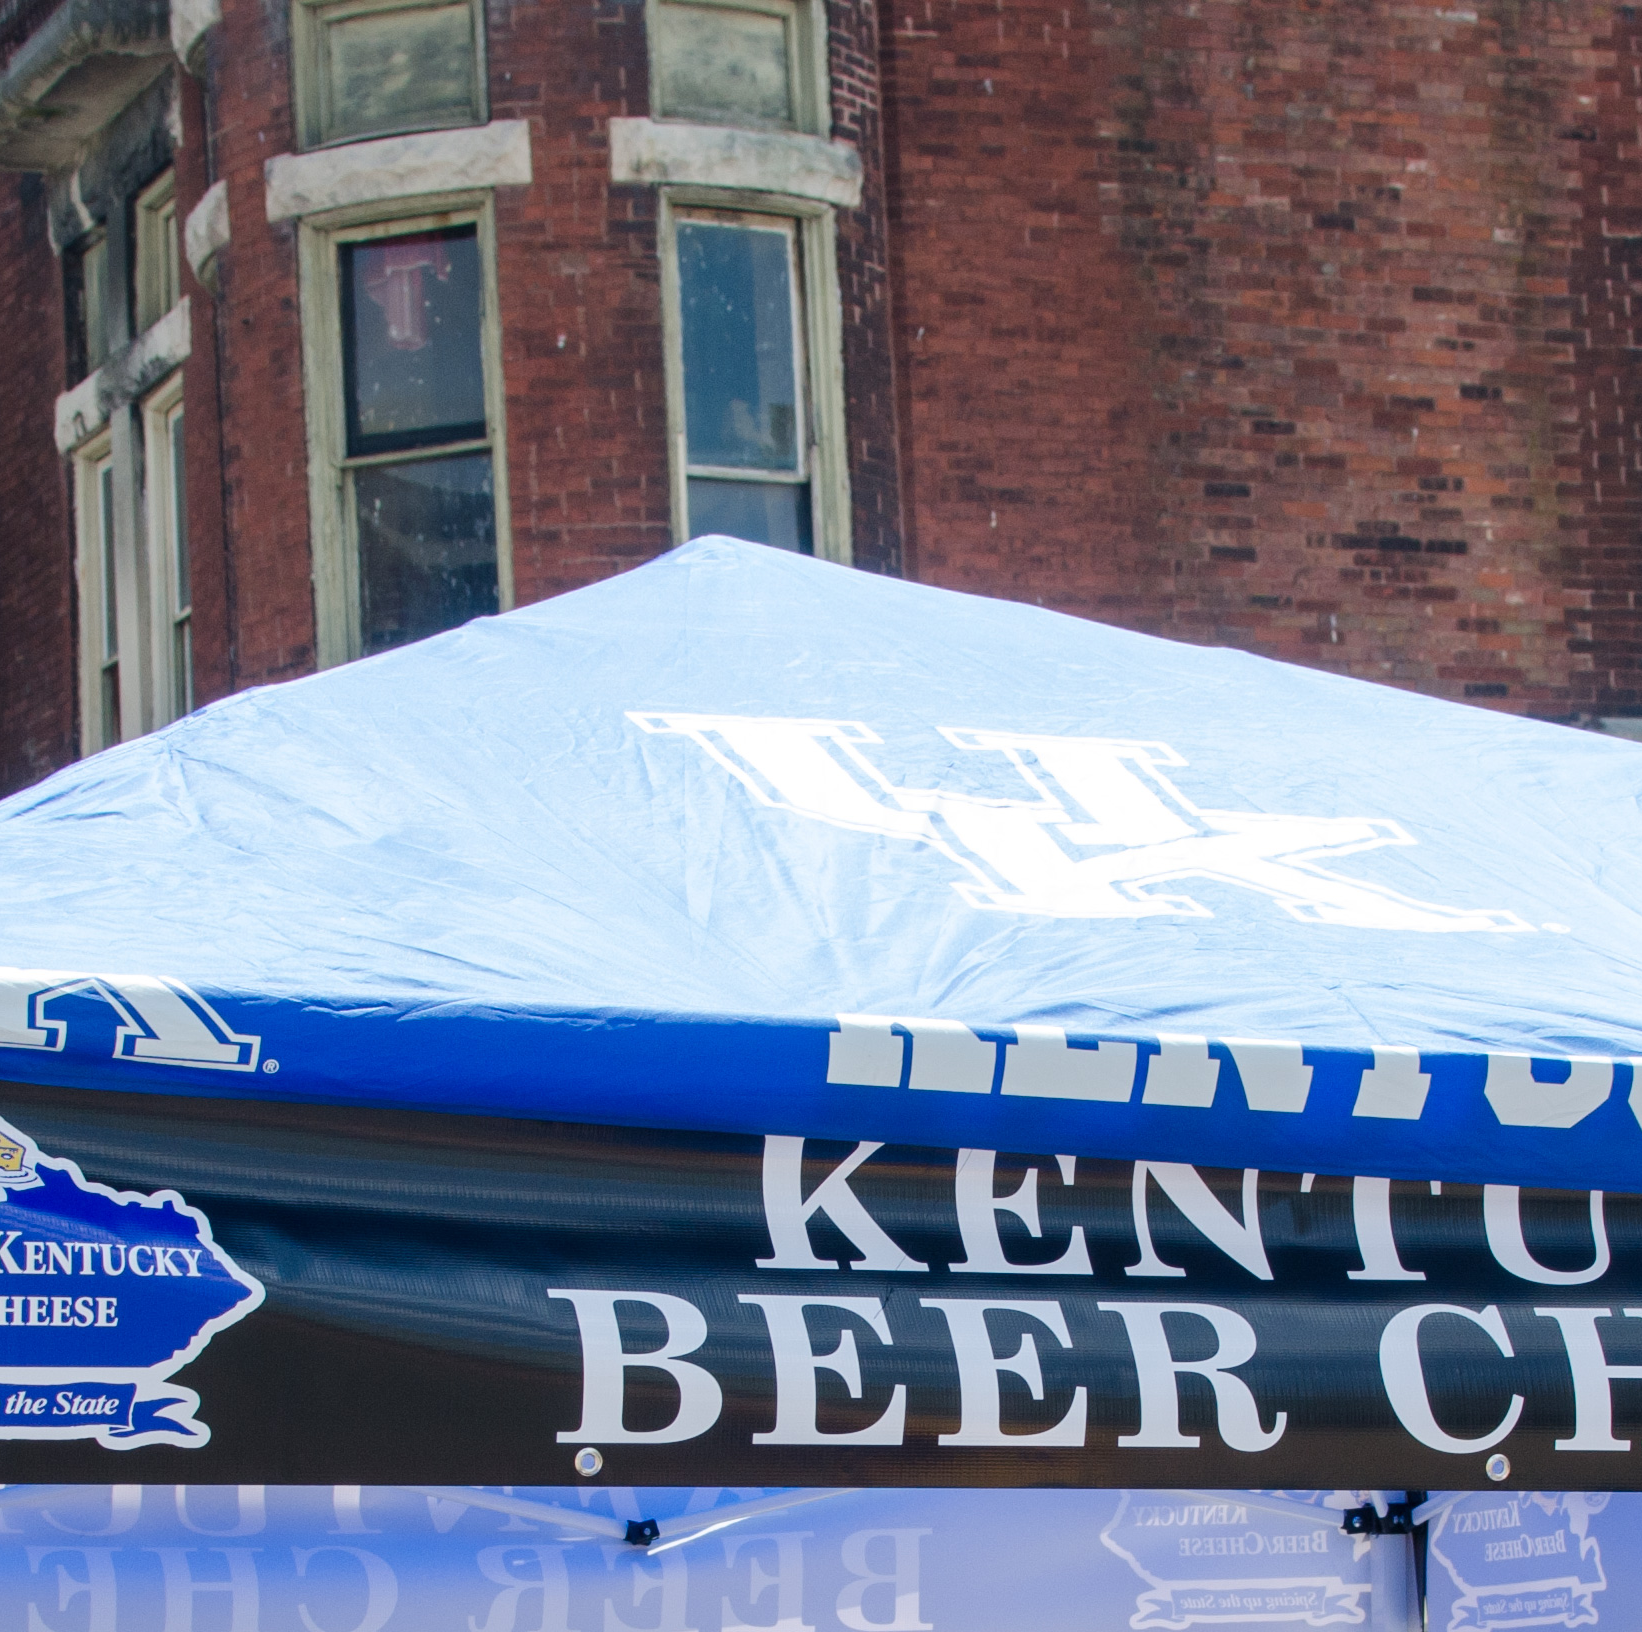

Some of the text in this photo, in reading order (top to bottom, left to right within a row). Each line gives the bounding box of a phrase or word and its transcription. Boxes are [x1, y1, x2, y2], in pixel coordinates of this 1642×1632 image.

[624, 711, 1539, 932] UK
[4, 1391, 50, 1416] the
[54, 1391, 118, 1416] State
[548, 1287, 1287, 1454] BEER
